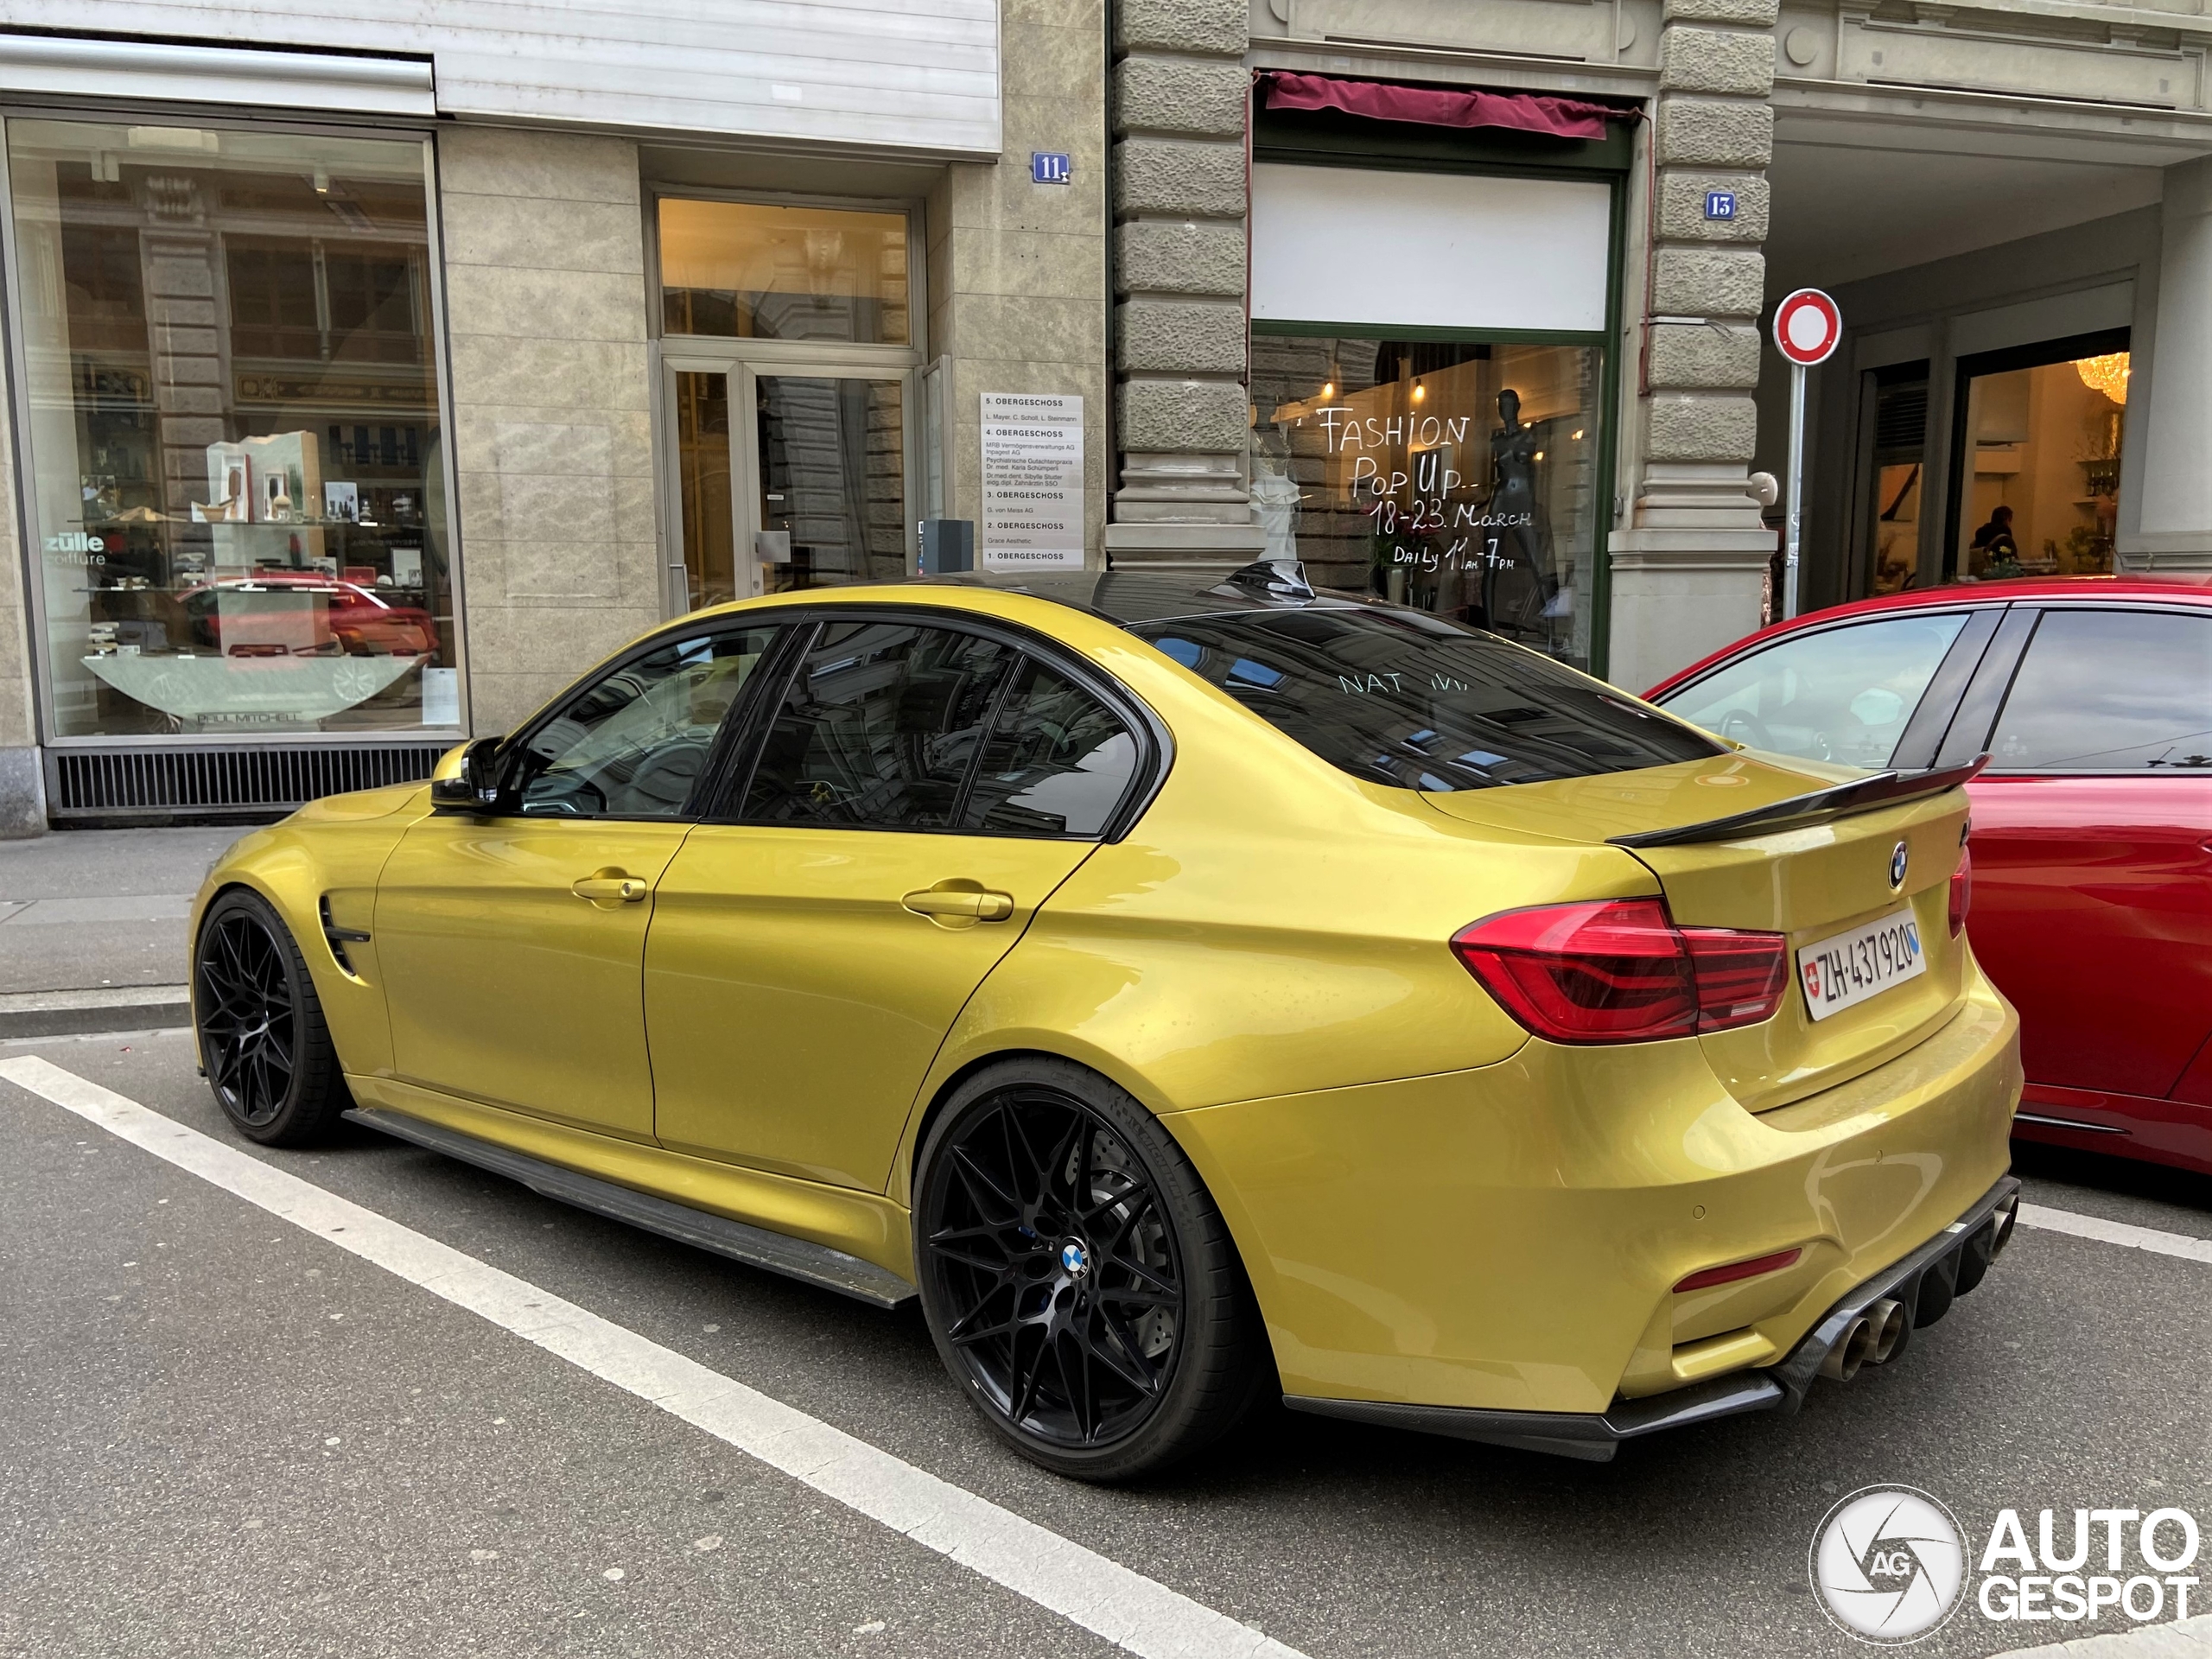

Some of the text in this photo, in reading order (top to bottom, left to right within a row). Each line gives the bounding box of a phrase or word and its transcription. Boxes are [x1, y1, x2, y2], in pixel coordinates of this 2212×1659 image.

[1042, 156, 1060, 179] 11
[1712, 196, 1730, 216] 13
[995, 397, 1063, 407] OBERGESCHOSS
[995, 429, 1064, 438] OBERGESCHOSS
[1001, 442, 1065, 451] Vermögensverwaltungs
[996, 491, 1064, 499] OBERGESCHOSS
[235, 712, 297, 723] MITCHELL
